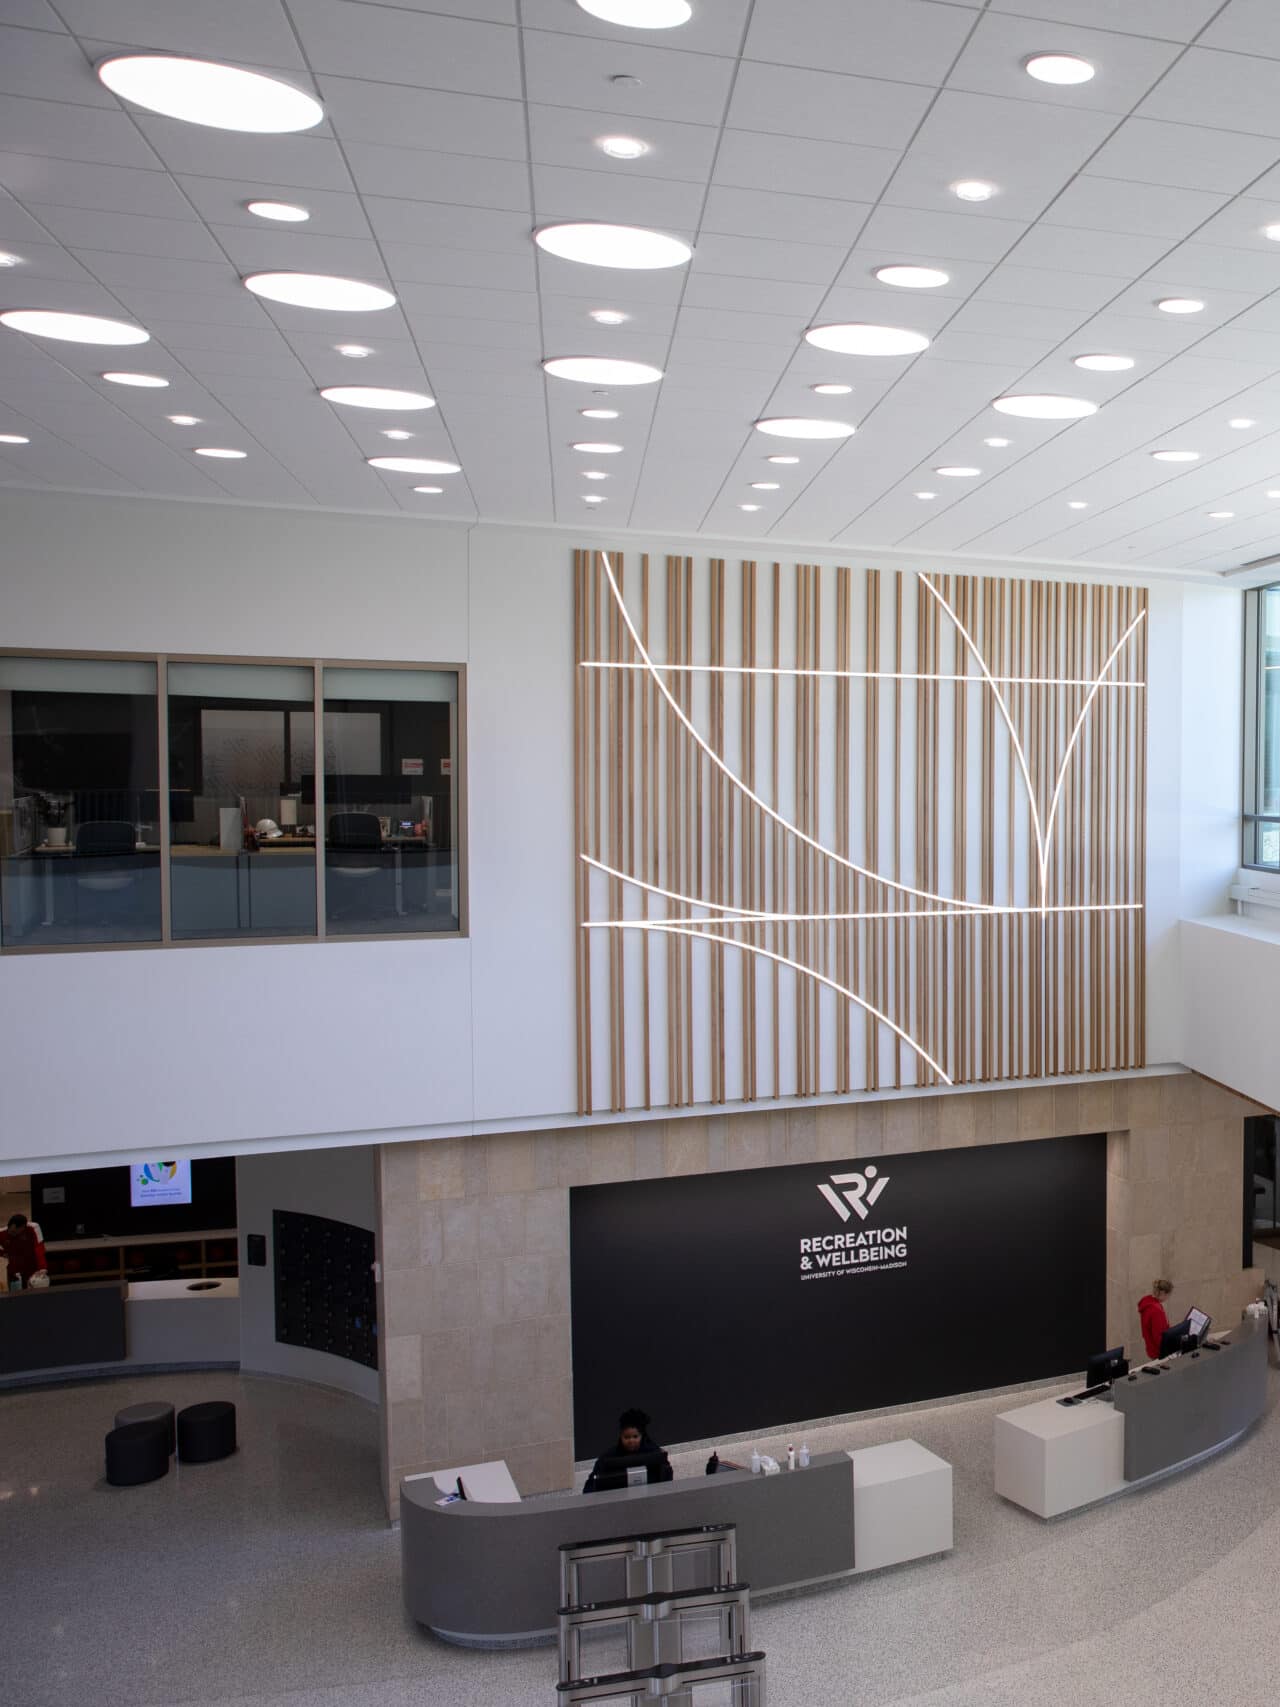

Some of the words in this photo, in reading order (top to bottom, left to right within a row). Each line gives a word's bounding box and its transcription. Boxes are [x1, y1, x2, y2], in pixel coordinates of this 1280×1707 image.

[800, 1226, 908, 1254] RECREATION
[800, 1255, 813, 1271] &
[815, 1243, 908, 1268] WELLBEING
[800, 1271, 836, 1281] UNIVERSITY
[836, 1269, 846, 1277] OF
